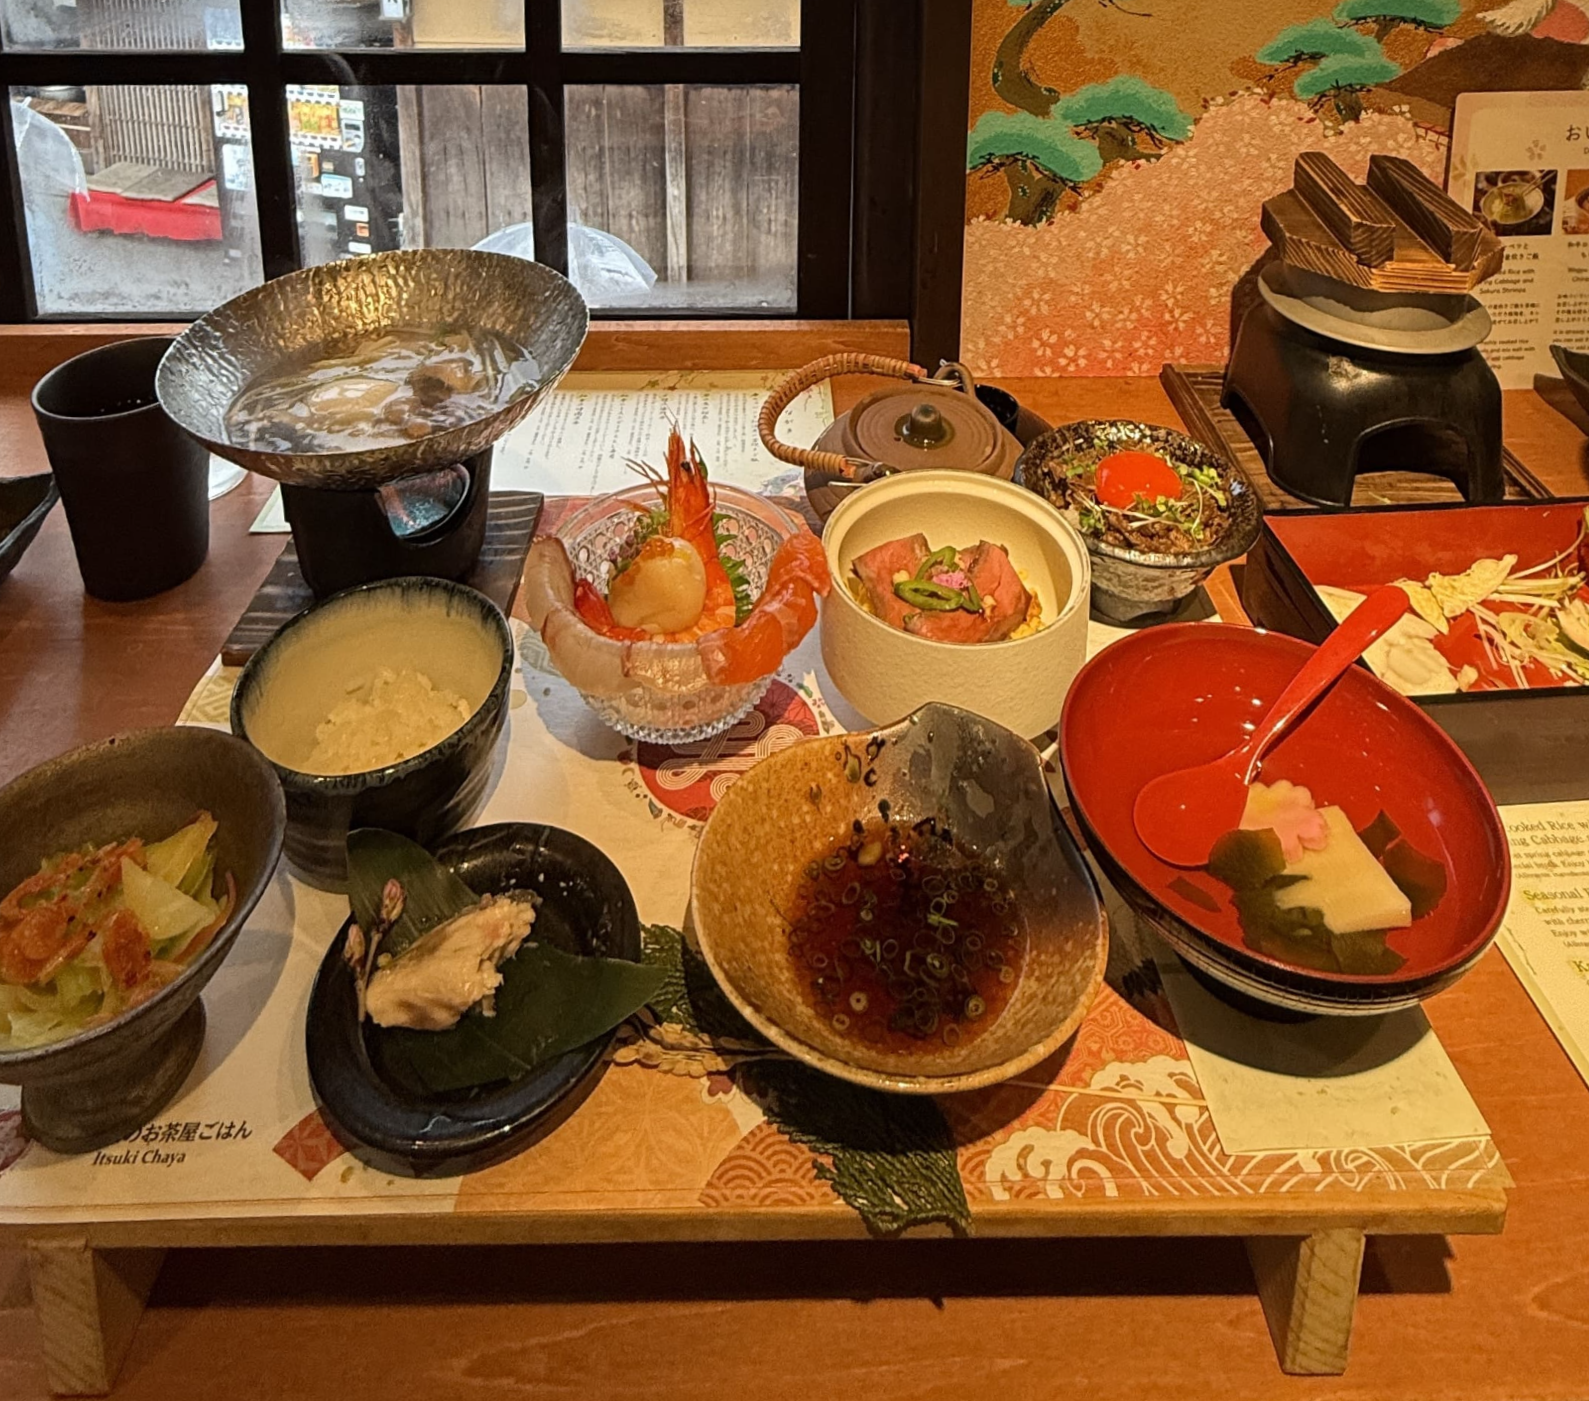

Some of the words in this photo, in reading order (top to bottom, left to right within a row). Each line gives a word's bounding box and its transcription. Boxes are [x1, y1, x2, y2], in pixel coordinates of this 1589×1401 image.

[1508, 820, 1547, 833] ooked
[1530, 833, 1585, 846] Cabbage
[1523, 888, 1584, 900] Seasonal
[92, 1148, 140, 1166] Itsuki
[142, 1148, 186, 1168] Chaya
